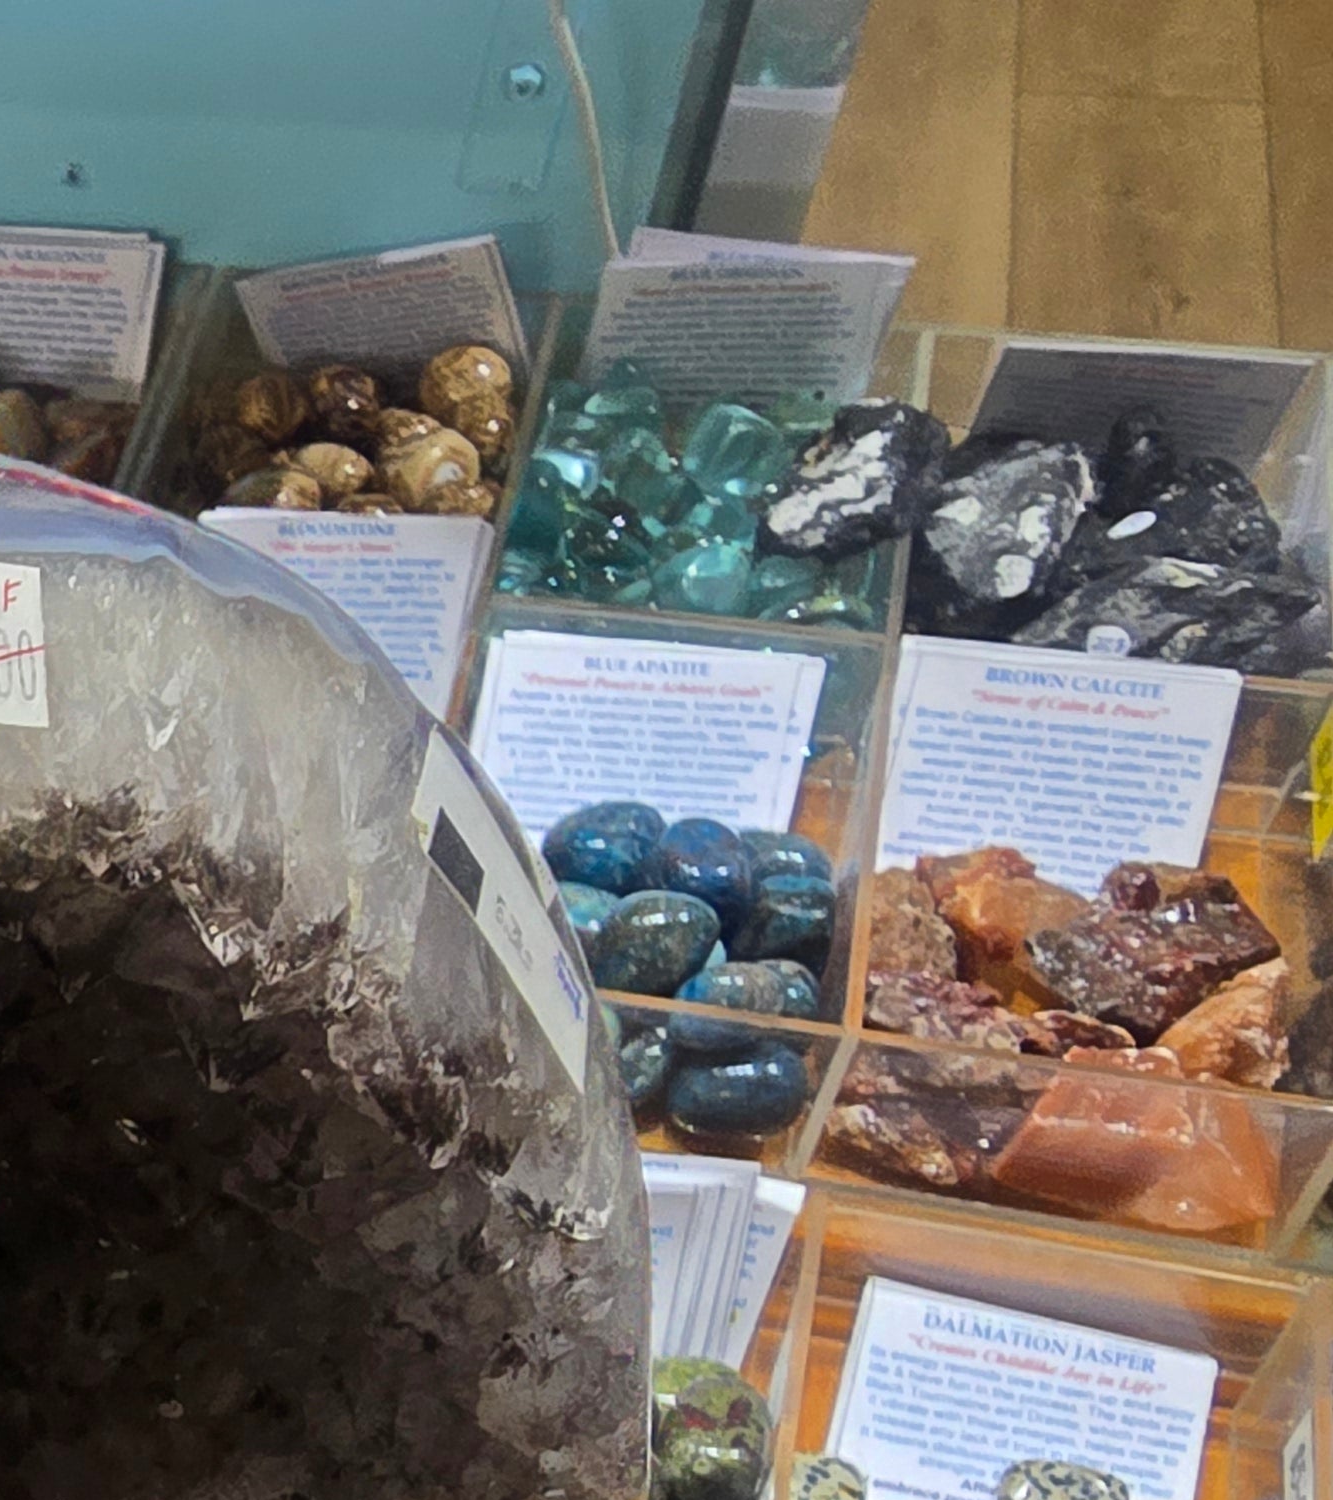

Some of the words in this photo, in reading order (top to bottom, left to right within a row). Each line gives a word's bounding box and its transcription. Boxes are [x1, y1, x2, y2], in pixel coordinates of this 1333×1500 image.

[582, 655, 629, 673] BLUE
[631, 656, 711, 678] APATITE
[983, 666, 1068, 689] BROWN
[1069, 674, 1165, 700] CALCITE
[921, 1311, 1069, 1357] DALMATION
[1072, 1342, 1157, 1375] JASPER
